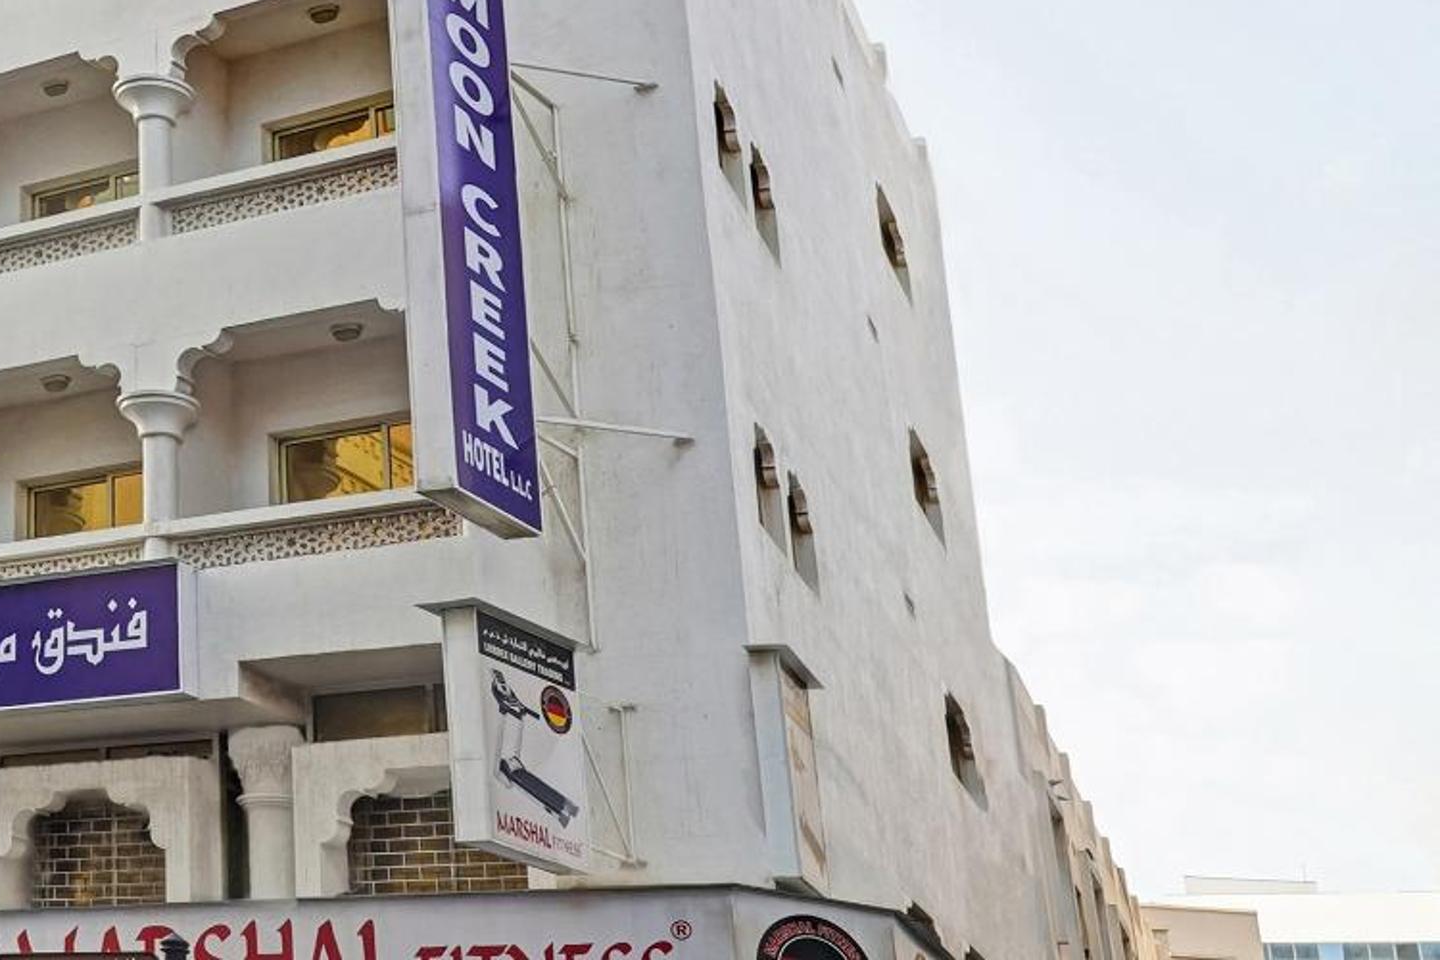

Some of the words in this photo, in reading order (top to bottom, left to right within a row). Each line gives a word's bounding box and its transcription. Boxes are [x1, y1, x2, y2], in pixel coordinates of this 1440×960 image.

[461, 183, 519, 450] CREEK
[462, 428, 509, 487] HOTEL
[31, 597, 147, 675] فندق
[496, 809, 552, 849] MARSHAL
